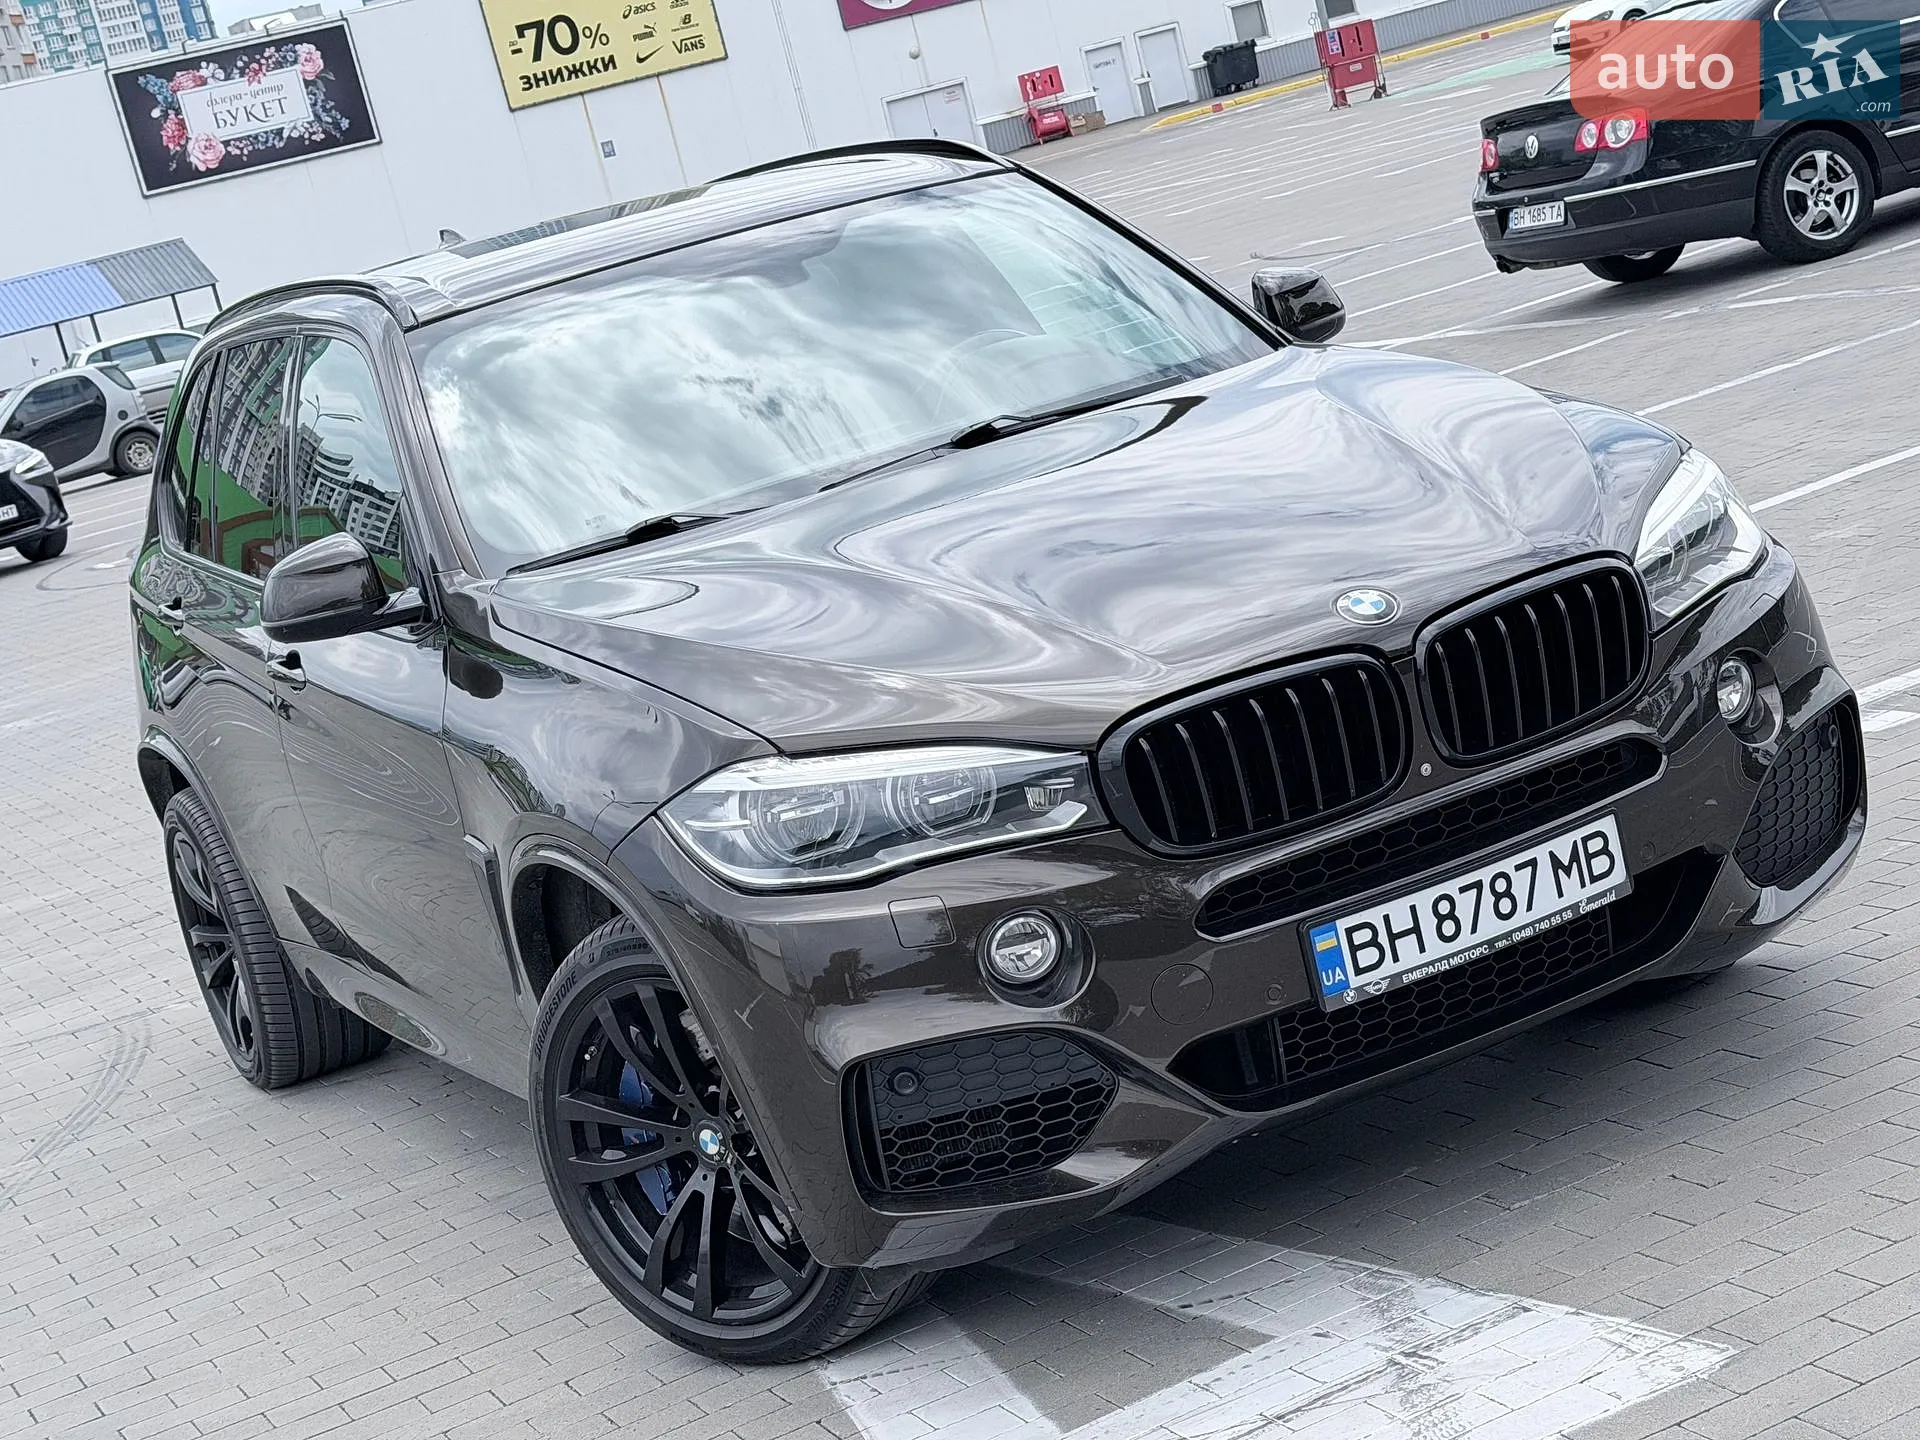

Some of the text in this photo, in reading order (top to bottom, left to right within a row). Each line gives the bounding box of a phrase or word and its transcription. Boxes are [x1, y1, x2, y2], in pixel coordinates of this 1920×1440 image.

[633, 2, 656, 15] asics
[519, 54, 618, 92] ЗНИЖКИ
[213, 96, 288, 129] БУКЕТ
[1513, 204, 1563, 226] BH 1685 TA
[1344, 829, 1616, 978] BH 8787 MB
[1579, 889, 1617, 915] Emerald
[1512, 925, 1535, 943] (048)
[1535, 920, 1550, 934] 740
[1550, 915, 1562, 927] 55
[1562, 909, 1573, 921] 55
[1322, 966, 1346, 986] UA
[1402, 944, 1489, 984] ЕМЕРАЛД МОТОРС
